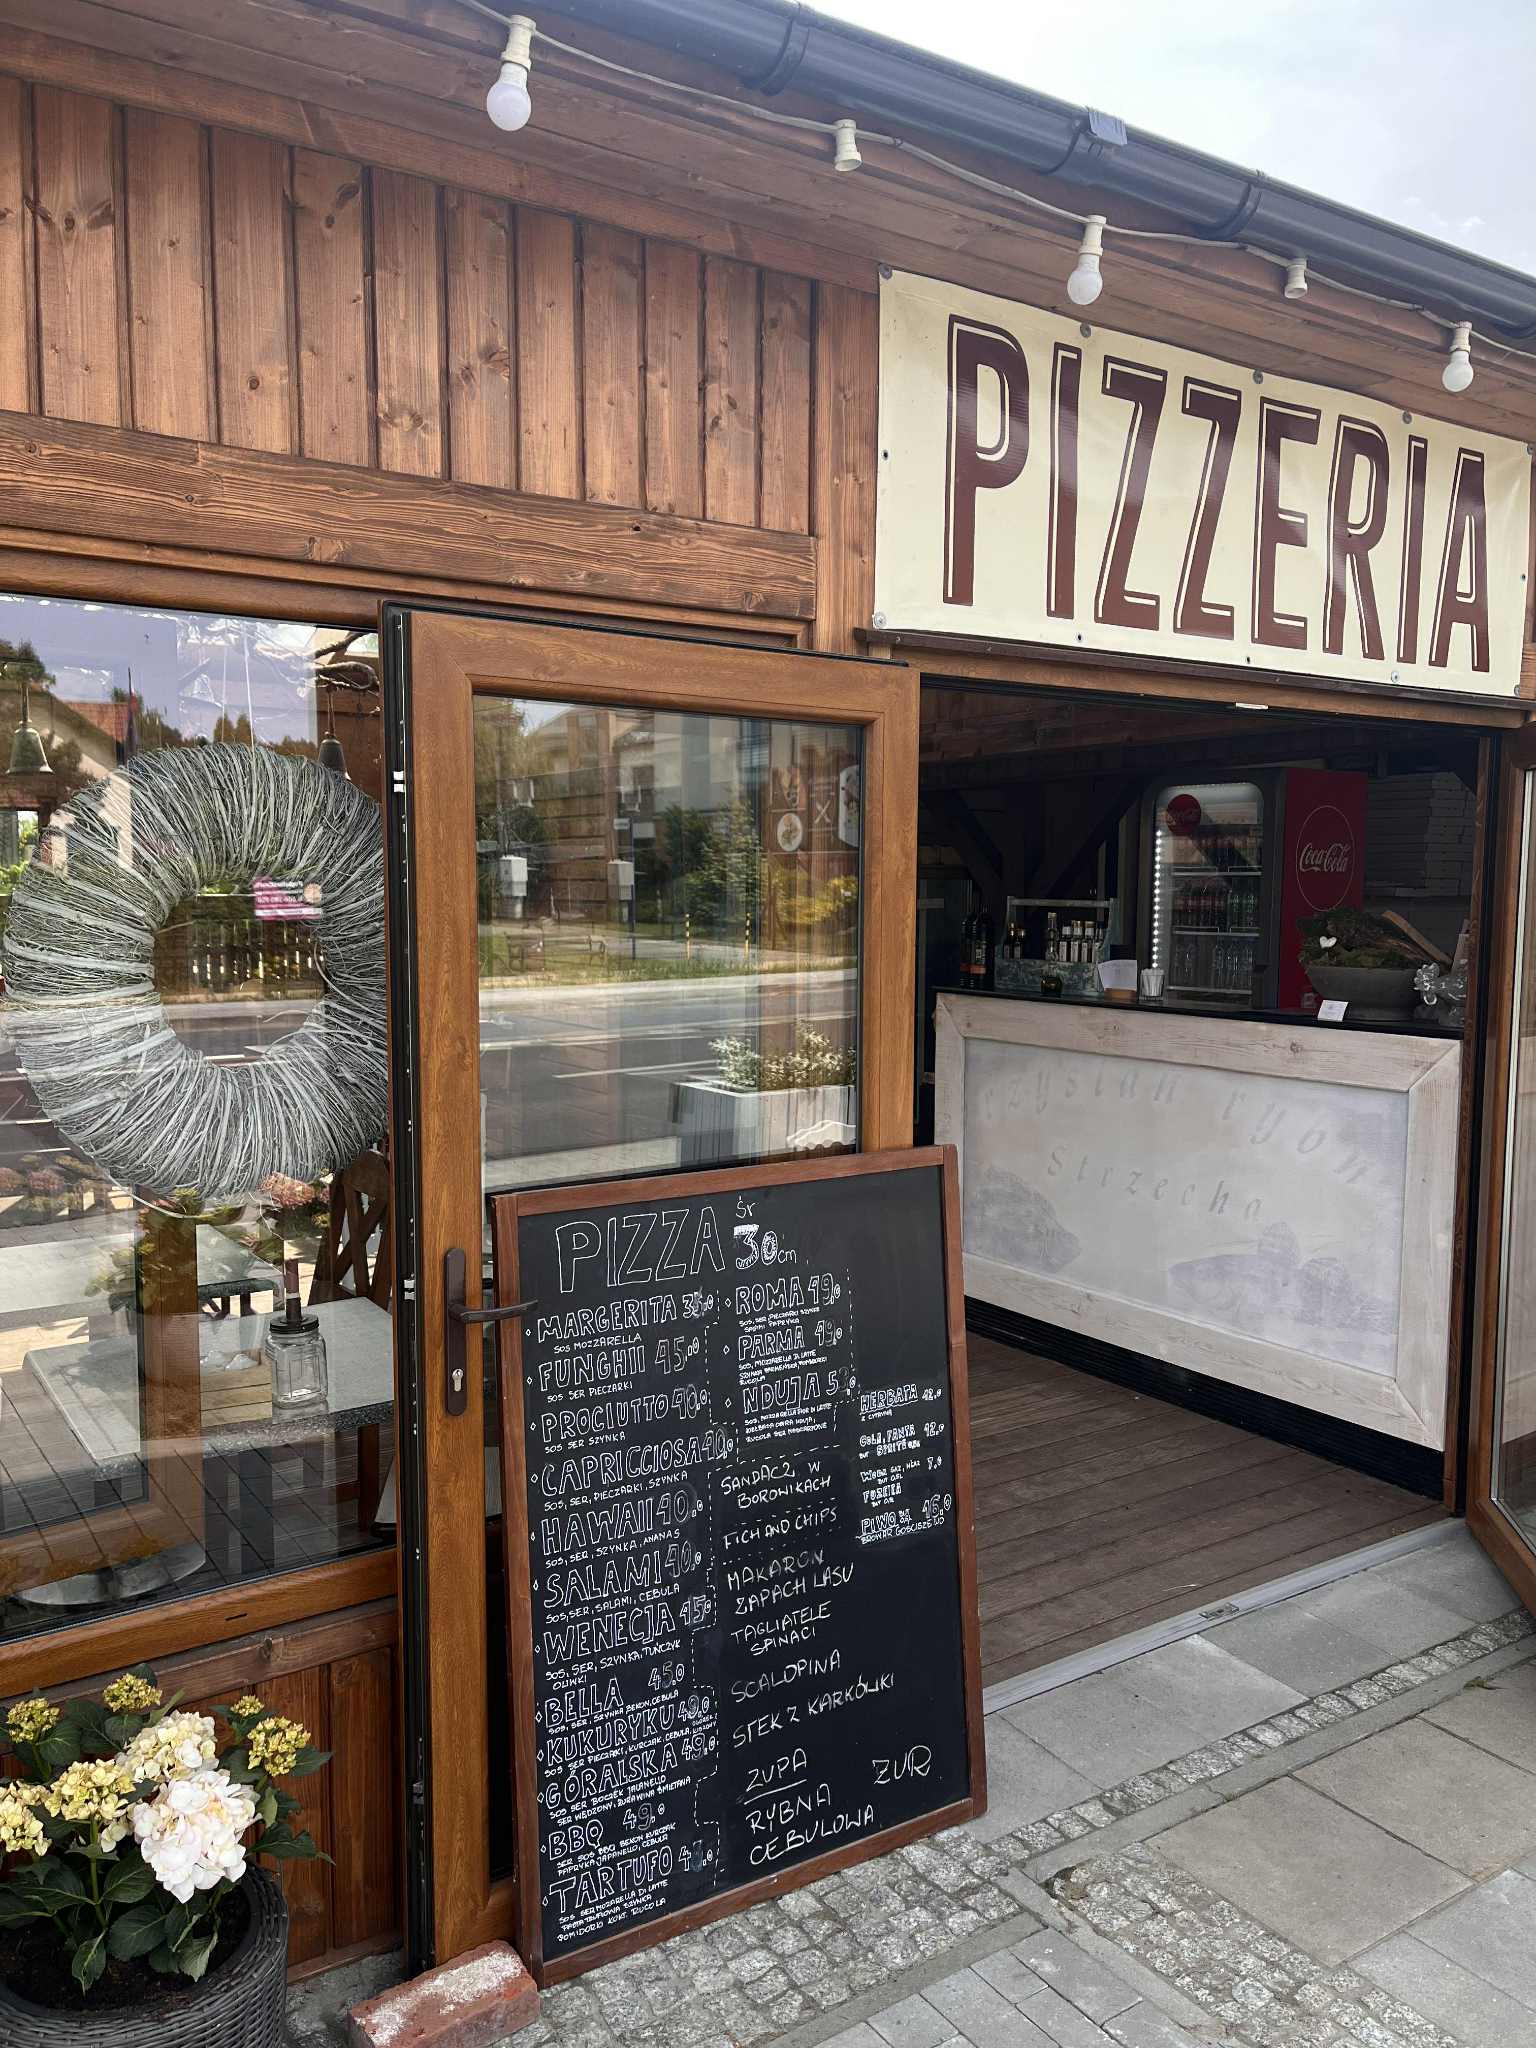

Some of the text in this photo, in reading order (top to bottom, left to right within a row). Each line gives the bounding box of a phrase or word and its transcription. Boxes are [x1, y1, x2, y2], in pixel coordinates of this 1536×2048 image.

[942, 312, 1491, 673] PIZZERIA
[555, 1206, 726, 1293] PIZZA
[735, 1276, 804, 1315] ROMA
[538, 1294, 677, 1343] MARGERITA
[573, 1333, 642, 1351] MOZZARELLA
[738, 1325, 805, 1361] PARMA
[538, 1345, 645, 1391] FUNGHII
[547, 1381, 633, 1403] SOS SER PIECZARKI
[742, 1372, 820, 1414] NDUJA
[860, 1383, 918, 1412] HERBATA
[541, 1394, 668, 1443] PROCIUTTO
[545, 1431, 626, 1454] SOS SER SZYNKA
[541, 1436, 702, 1497] CAPRICCIOSA
[649, 1470, 688, 1488] SZYNKA
[720, 1461, 821, 1495] SANDACZ W
[737, 1475, 831, 1509] BOROWIKACH
[541, 1498, 653, 1556] HAWAII
[643, 1528, 681, 1545] ANANAS
[723, 1506, 837, 1550] FICH AND CHIPS
[861, 1511, 897, 1535] PIWO
[543, 1550, 662, 1609] SALAMI
[639, 1583, 680, 1601] CEBULA
[727, 1549, 825, 1592] MAKARON
[735, 1562, 854, 1615] ZAPACH LASU
[543, 1602, 676, 1665] WENECJA
[730, 1600, 833, 1645] TAGLIATELE
[749, 1626, 816, 1656] SPINACI
[552, 1677, 587, 1690] OLIWKI
[652, 1689, 679, 1705] CEBULA
[730, 1648, 841, 1703] SCALOPINA
[545, 1677, 624, 1728] BELLA
[732, 1671, 895, 1748] STEK Z KARKÓWKI
[547, 1703, 675, 1766] KUKURYKU
[544, 1768, 563, 1778] SOS
[568, 1760, 585, 1771] SER
[545, 1742, 678, 1809] GÓRALSKA
[745, 1748, 807, 1792] ZUPA
[549, 1789, 624, 1819] SOS SER BOCZEK
[557, 1817, 572, 1826] SER
[745, 1783, 831, 1834] RYBNA
[549, 1819, 604, 1861] BBQ
[558, 1860, 596, 1877] PAPRYKA
[641, 1834, 668, 1848] CEBULA
[749, 1804, 874, 1865] CEBULOWA
[549, 1845, 673, 1914] TARTUFO
